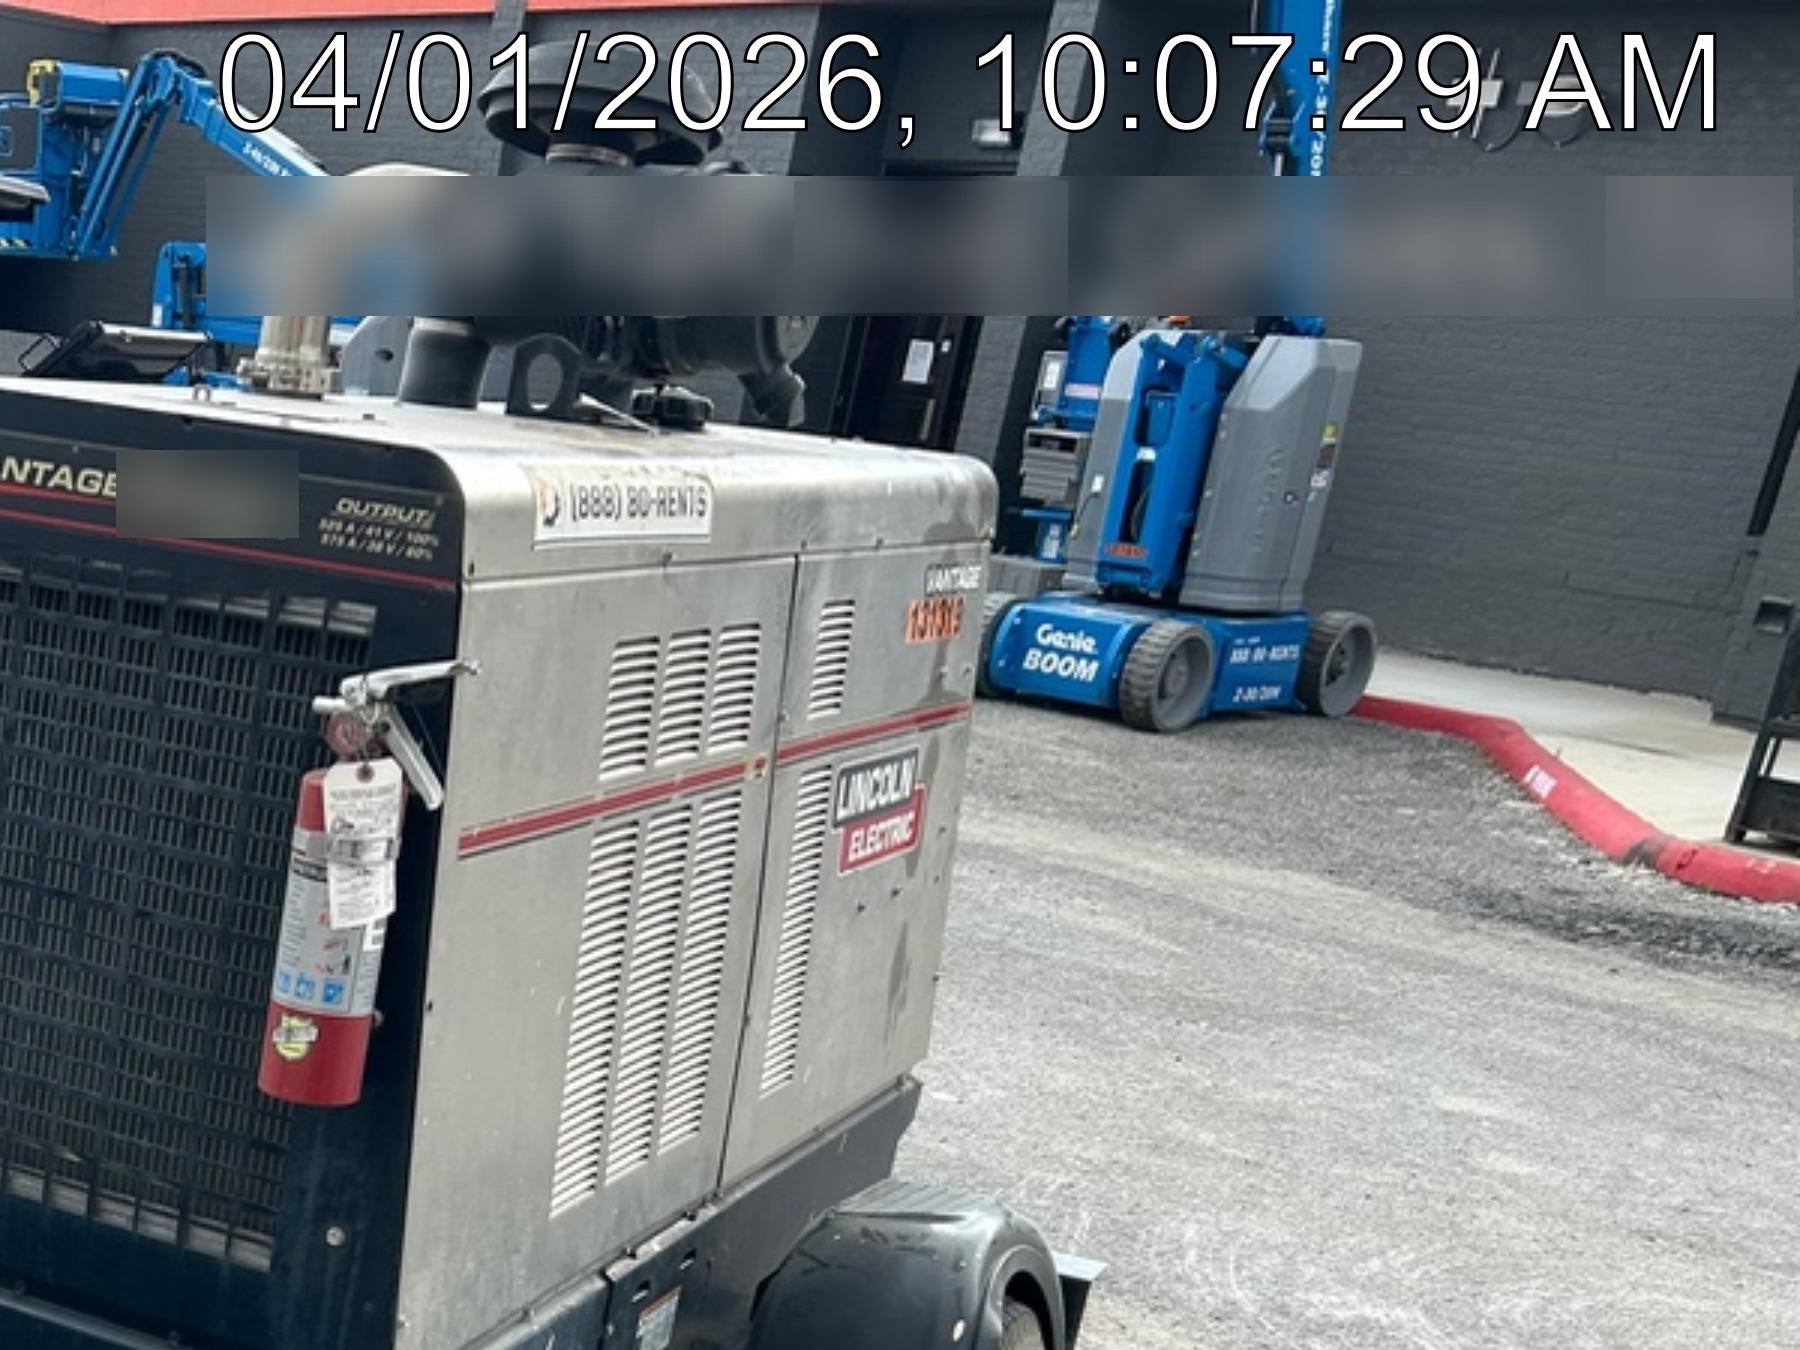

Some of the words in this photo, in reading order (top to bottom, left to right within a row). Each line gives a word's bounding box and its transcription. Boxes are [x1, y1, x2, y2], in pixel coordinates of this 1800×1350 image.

[336, 498, 429, 523] OUTPUT
[570, 482, 622, 522] (888)
[1036, 623, 1097, 655] Genie
[1022, 647, 1099, 682] BOOM
[837, 757, 916, 821] LINCOLN
[848, 811, 916, 863] ELECTRIC
